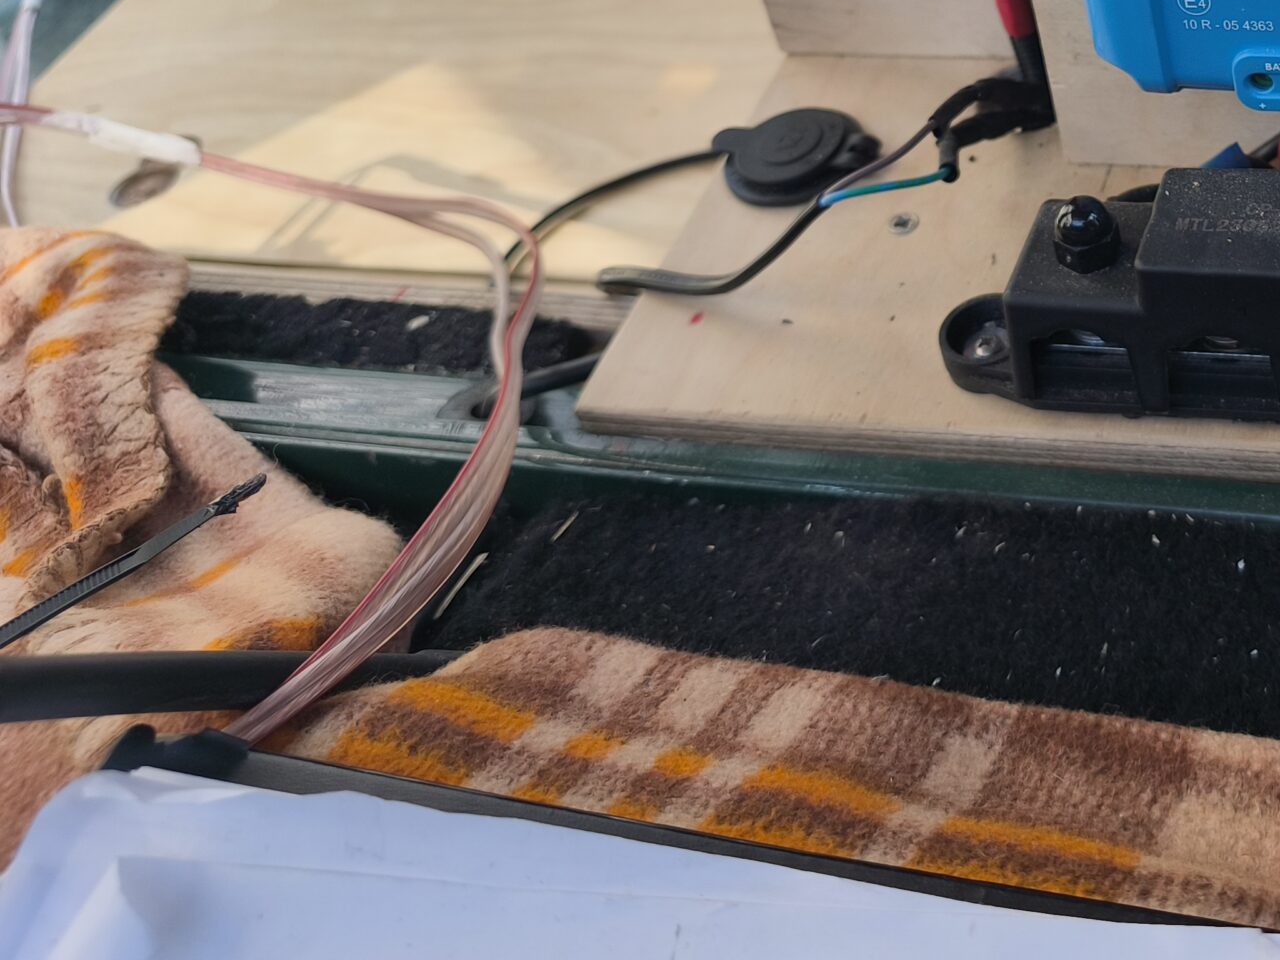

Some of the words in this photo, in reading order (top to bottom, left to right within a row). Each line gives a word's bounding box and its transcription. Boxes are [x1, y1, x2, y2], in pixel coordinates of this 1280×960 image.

[1183, 19, 1198, 30] 10
[1201, 19, 1212, 30] R
[1223, 20, 1239, 31] 05
[1242, 20, 1275, 32] 4363
